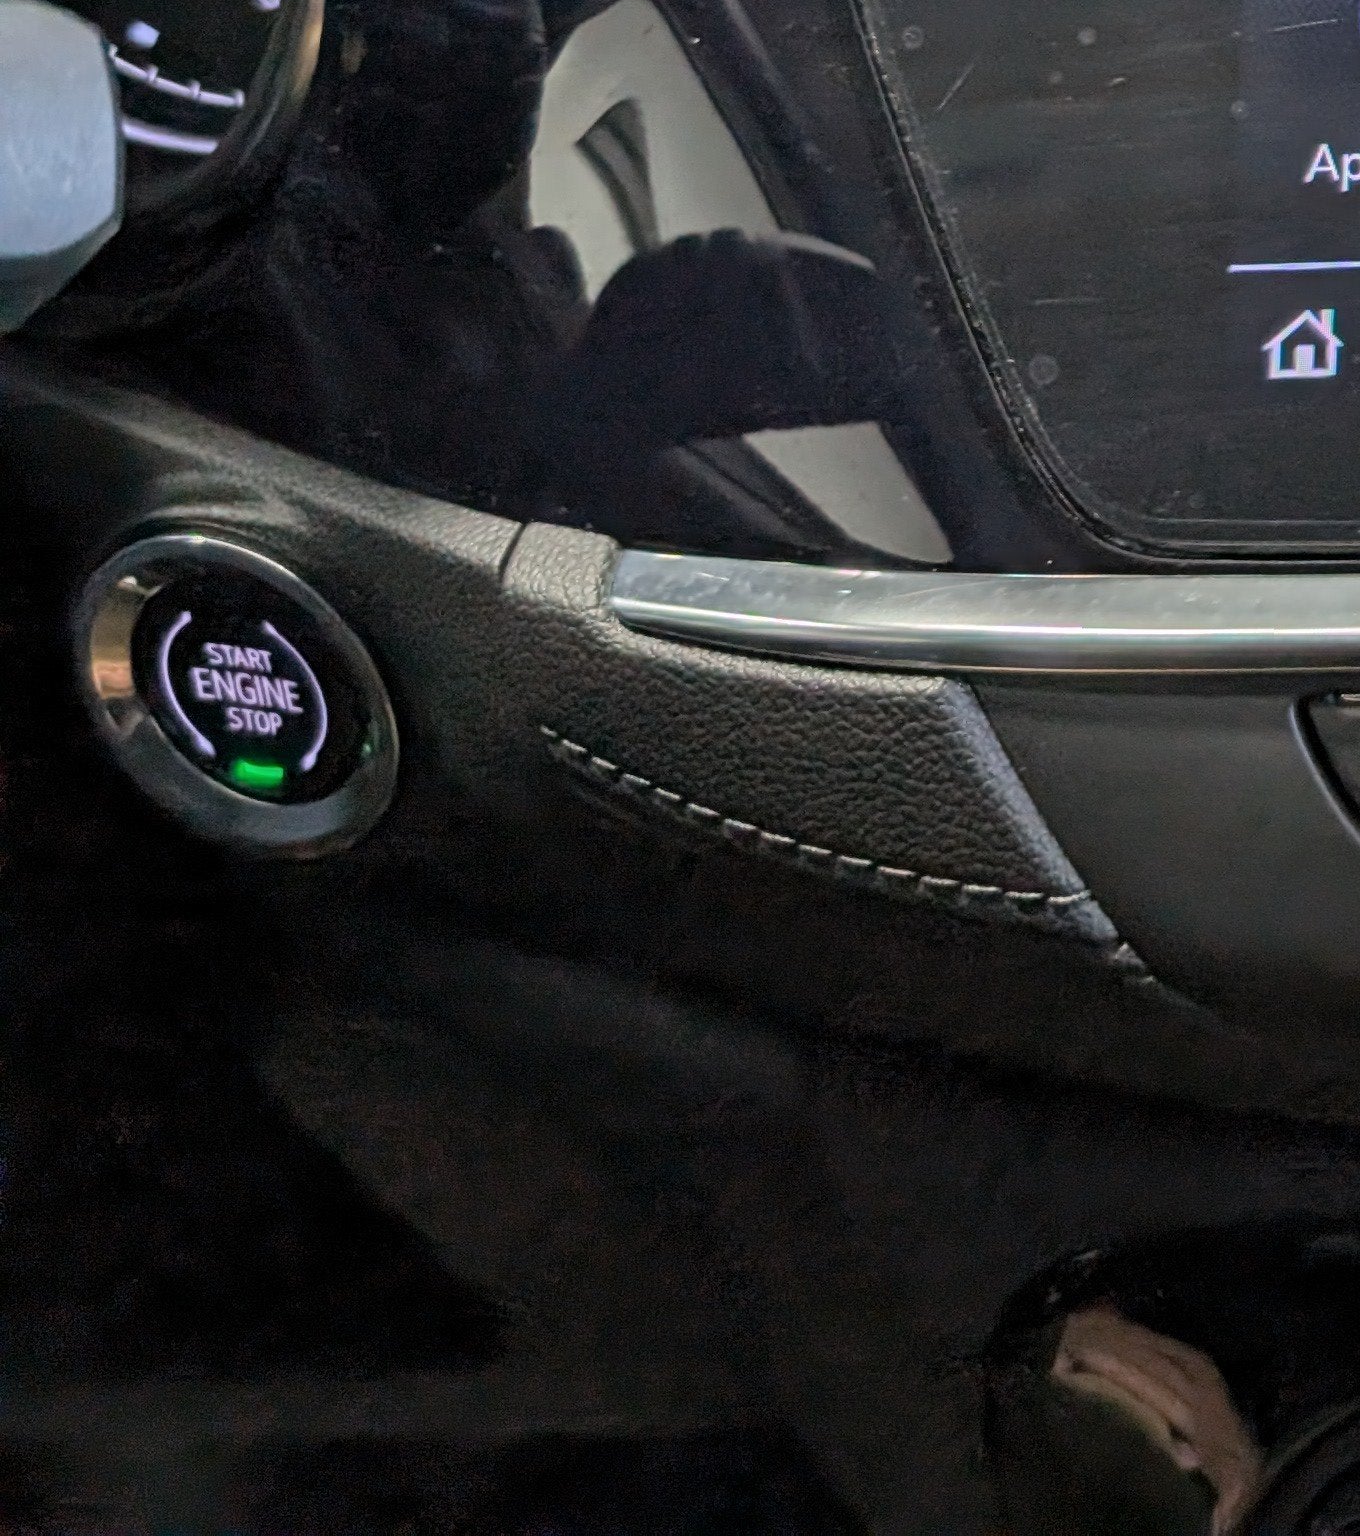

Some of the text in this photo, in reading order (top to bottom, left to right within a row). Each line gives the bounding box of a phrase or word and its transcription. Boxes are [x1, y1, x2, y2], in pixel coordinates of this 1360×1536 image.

[203, 641, 272, 673] START
[190, 667, 304, 714] ENGINE
[226, 706, 283, 736] STOP
